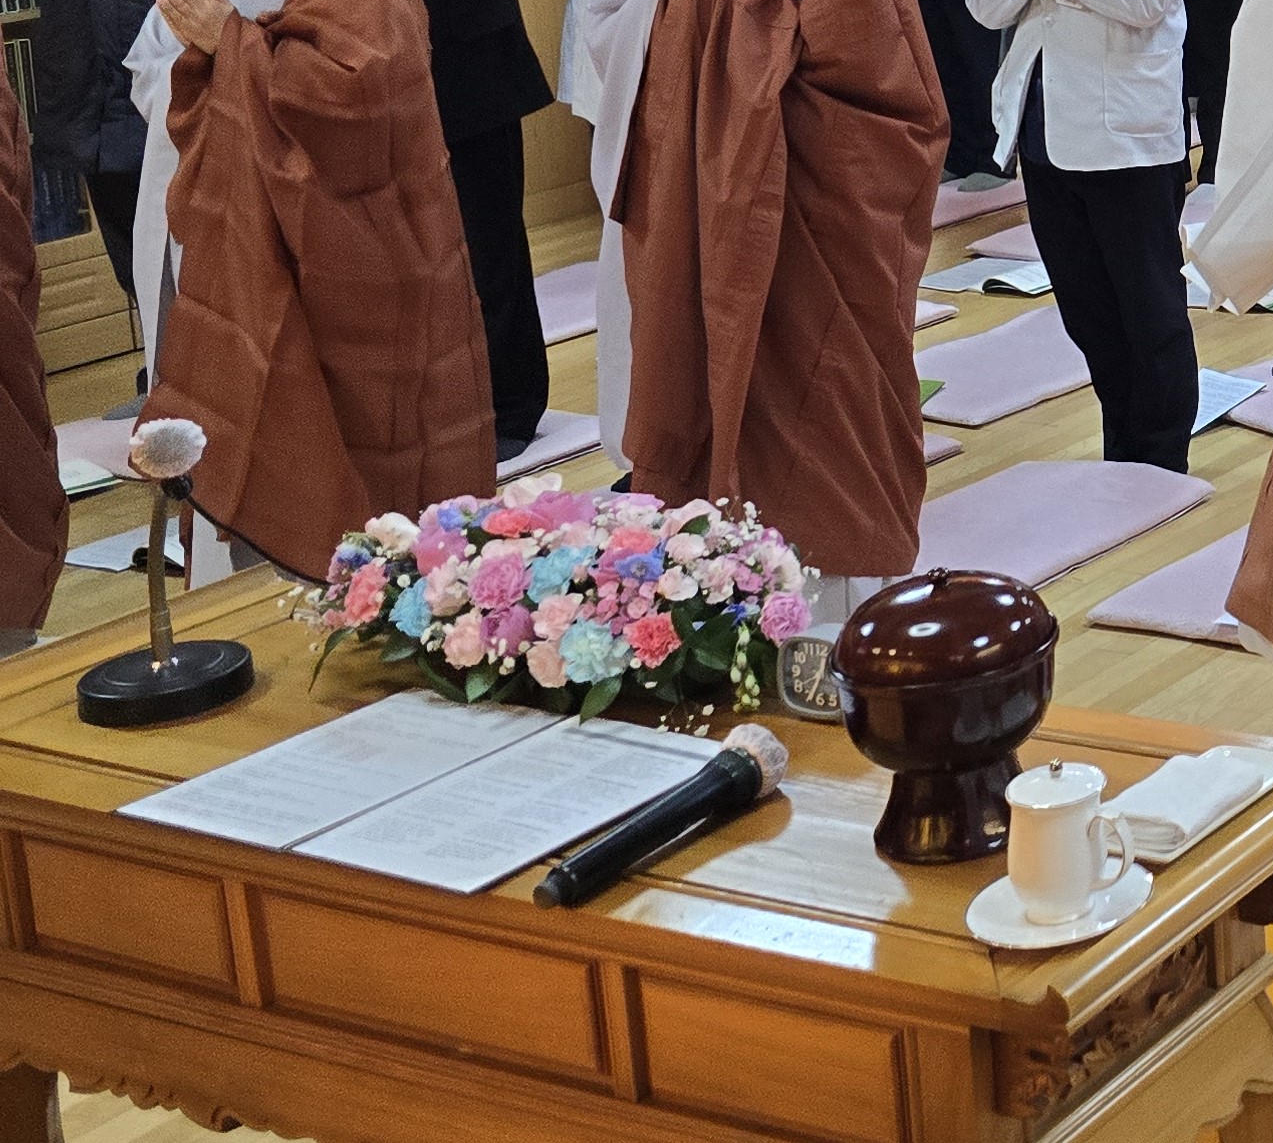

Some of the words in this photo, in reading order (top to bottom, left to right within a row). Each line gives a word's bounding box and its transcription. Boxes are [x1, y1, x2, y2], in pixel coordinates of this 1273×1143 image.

[793, 650, 807, 664] 10
[803, 643, 814, 657] 11
[815, 643, 829, 658] 12
[791, 664, 802, 677] 9
[794, 679, 803, 693] 8
[815, 692, 825, 706] 6
[828, 693, 838, 707] 5
